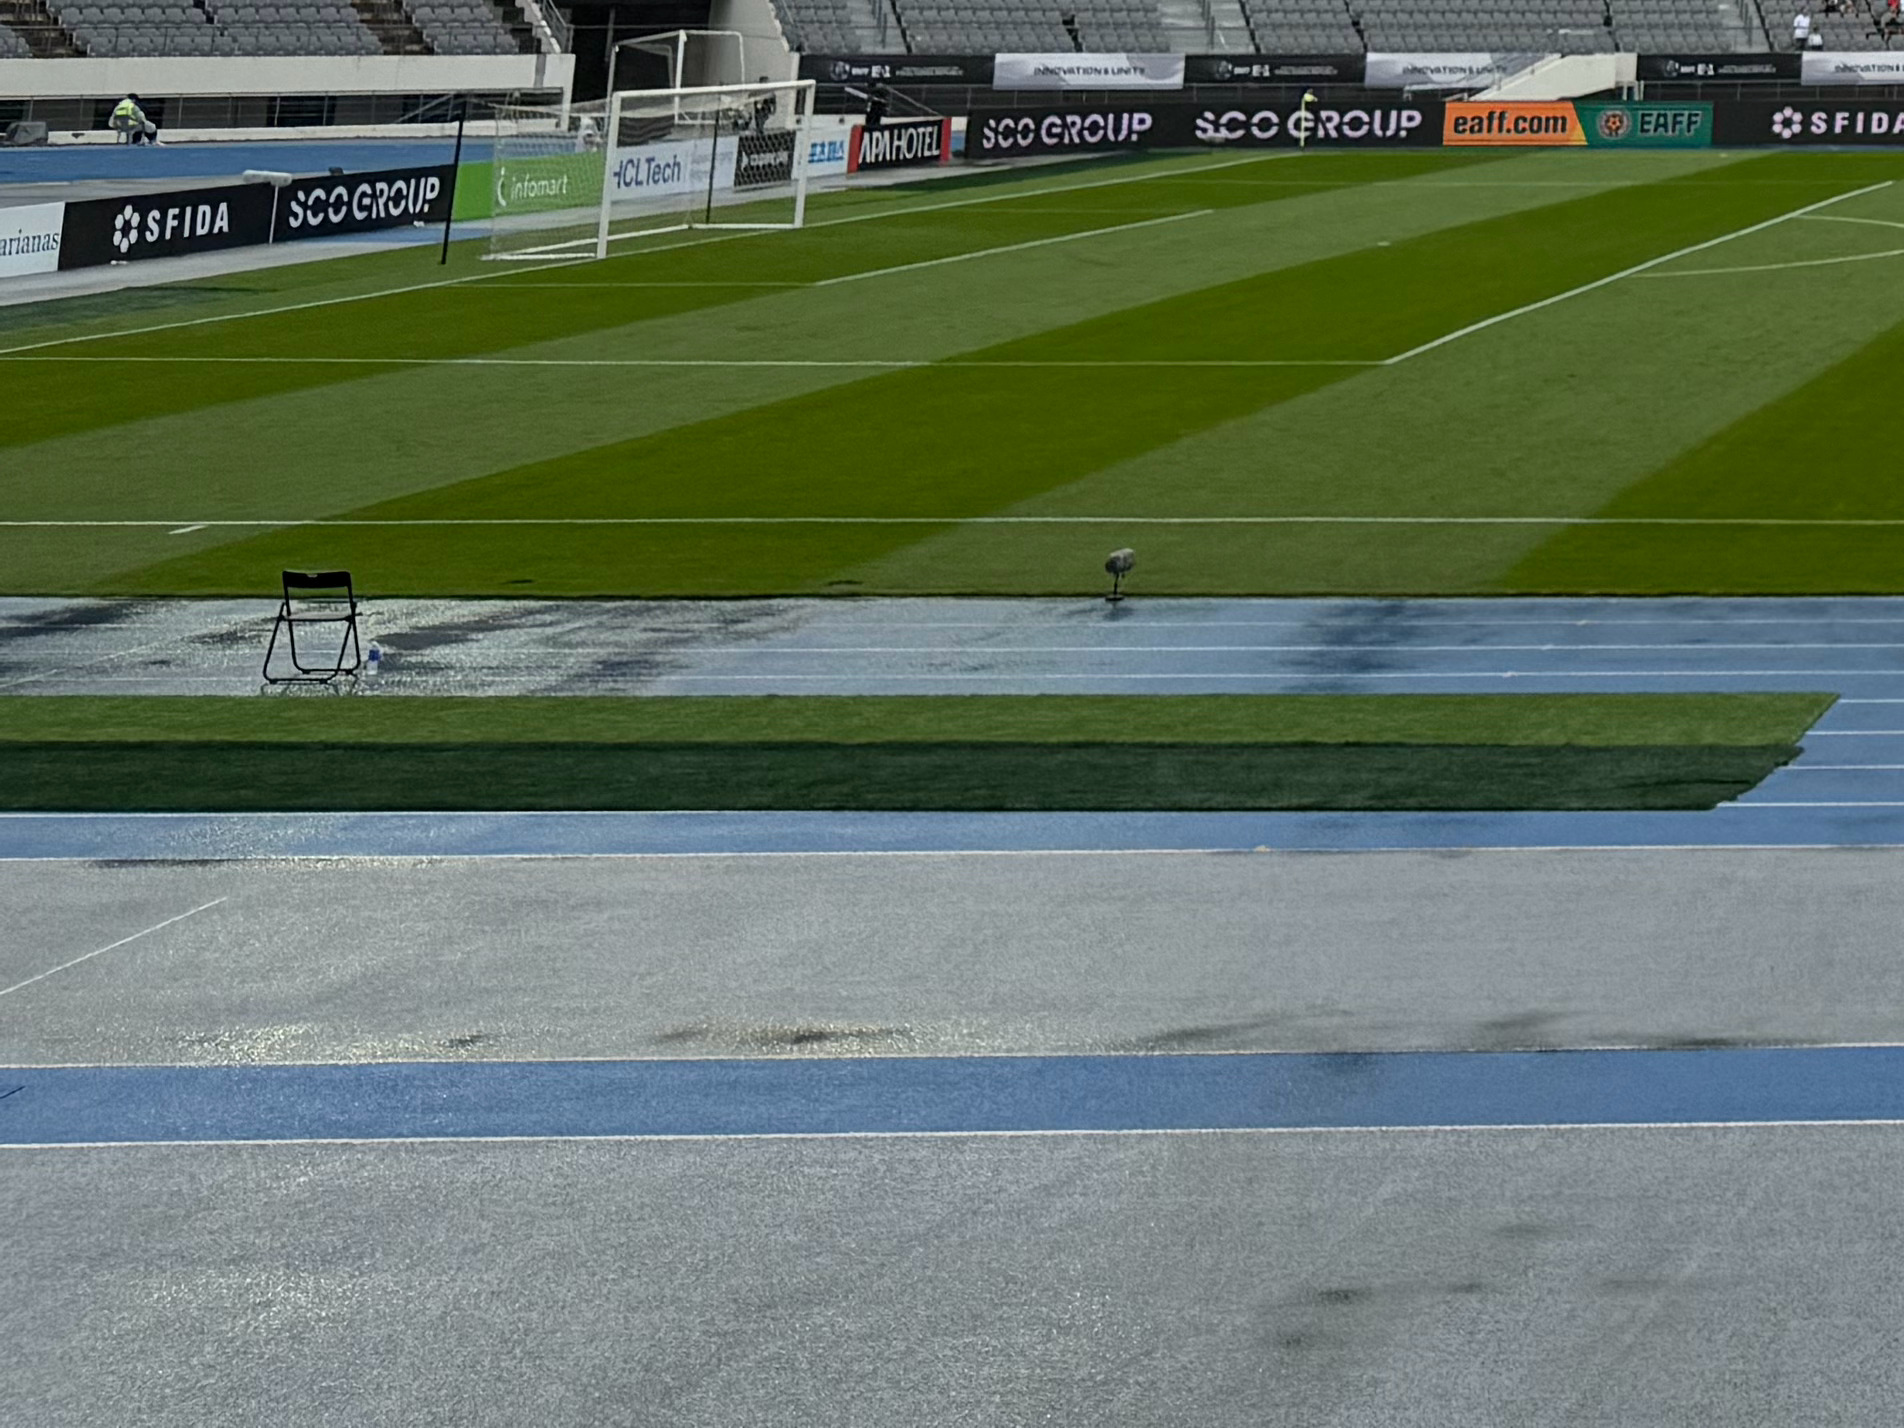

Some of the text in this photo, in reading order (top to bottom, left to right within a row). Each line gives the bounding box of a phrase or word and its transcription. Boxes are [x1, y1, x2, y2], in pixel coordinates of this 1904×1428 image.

[982, 112, 1153, 149] SCO GROUP
[1195, 110, 1422, 139] SCO GROUP
[1454, 110, 1567, 136] eaff.com
[1639, 111, 1701, 137] EAFF
[859, 126, 940, 164] APA HOTEL
[289, 177, 440, 229] SCO GROUP
[511, 174, 568, 200] infomart
[145, 202, 229, 242] SFIDA
